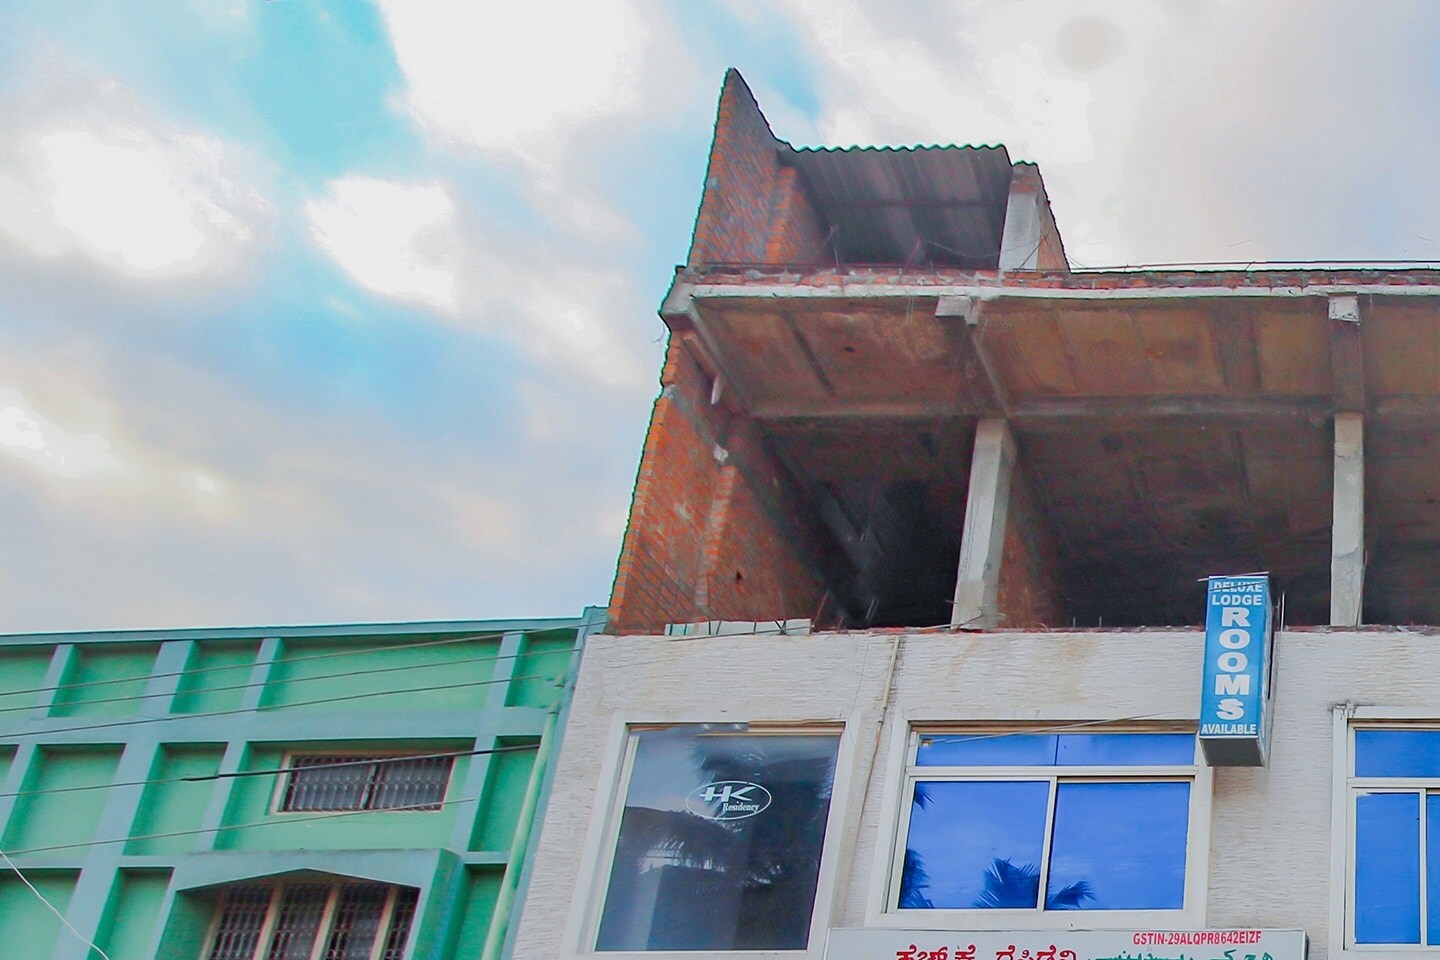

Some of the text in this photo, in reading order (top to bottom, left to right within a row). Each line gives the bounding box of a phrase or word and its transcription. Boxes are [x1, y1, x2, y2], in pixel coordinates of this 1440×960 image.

[1213, 581, 1263, 593] DELUXE
[1211, 594, 1262, 605] LODGE
[1214, 607, 1251, 721] ROOMS
[1201, 723, 1257, 735] AVAILABLE
[699, 785, 757, 803] HK
[722, 801, 760, 813] Residency
